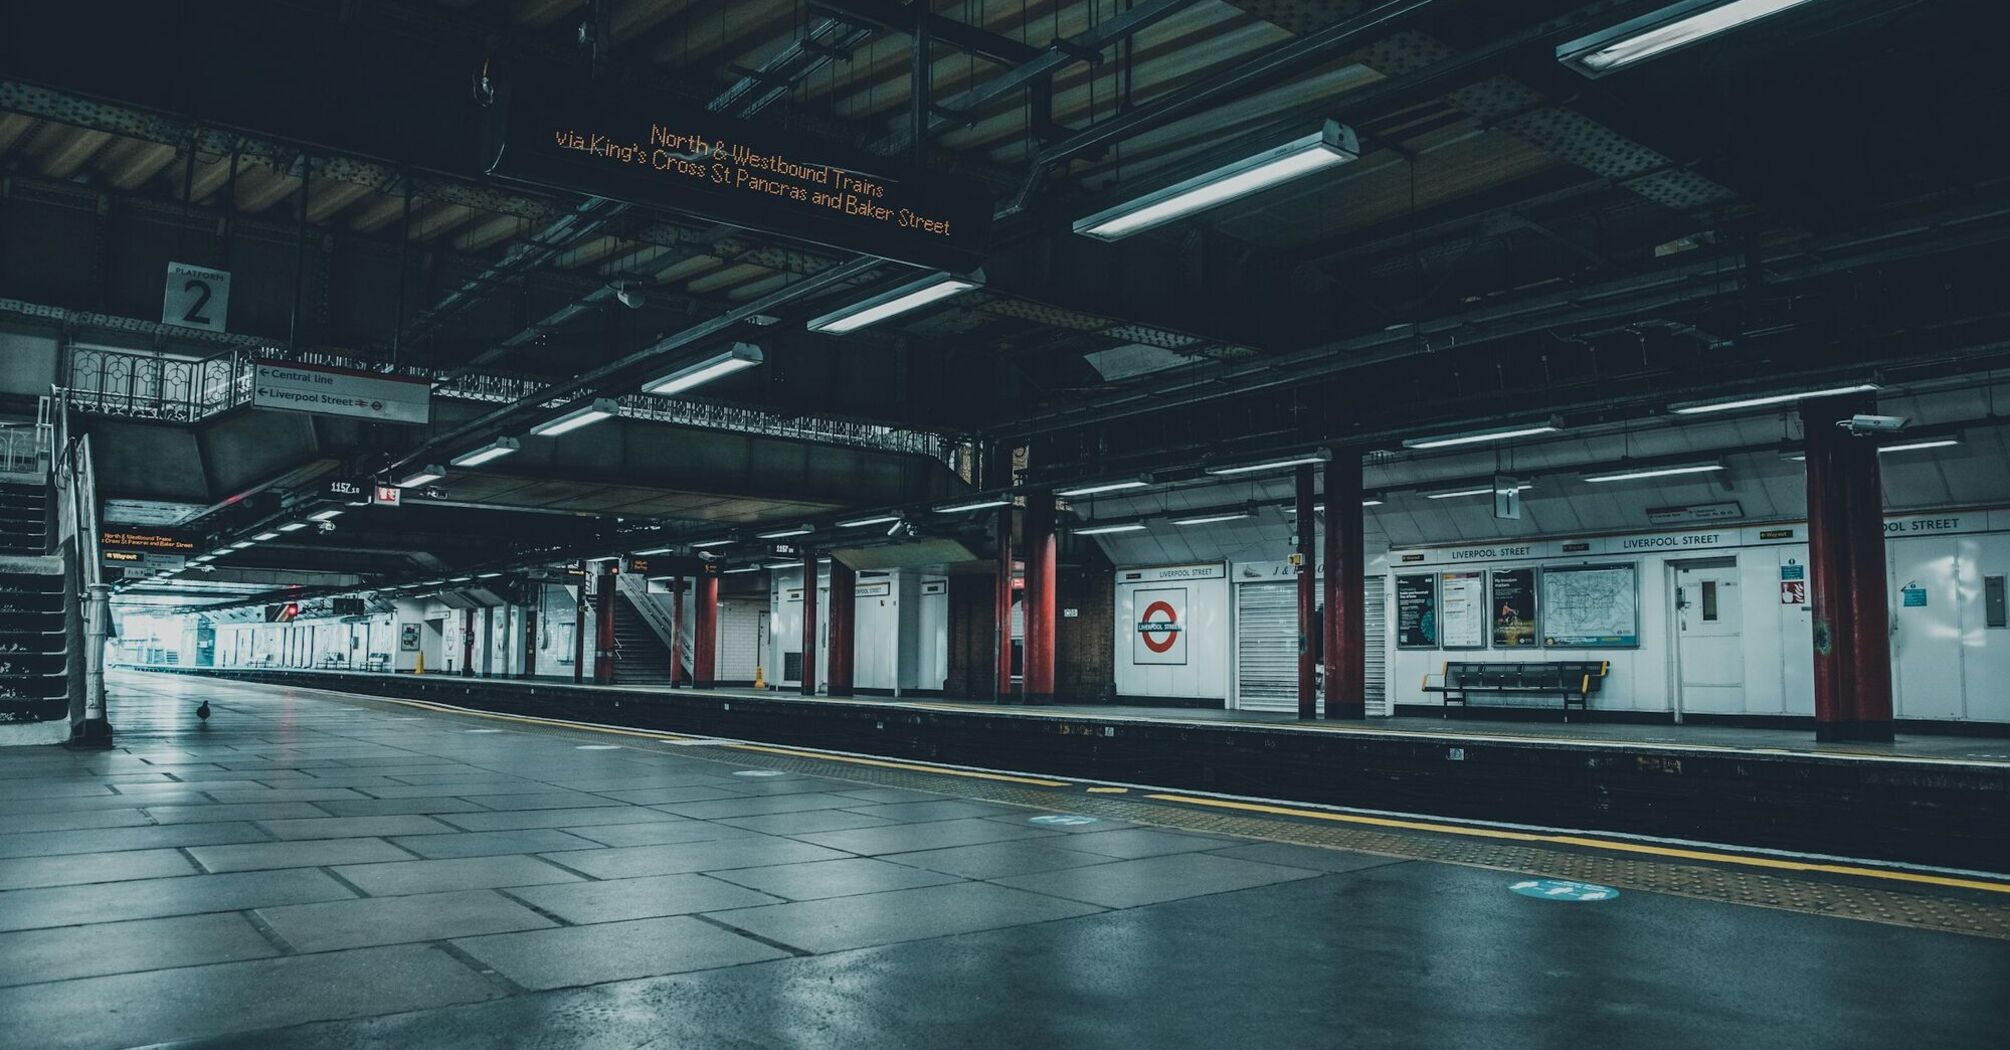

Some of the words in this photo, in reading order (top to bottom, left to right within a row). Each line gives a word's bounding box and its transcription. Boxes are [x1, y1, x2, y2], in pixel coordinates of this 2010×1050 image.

[651, 124, 708, 155] North
[713, 141, 726, 159] &
[732, 144, 827, 184] Westbound
[832, 169, 883, 197] Trains
[556, 130, 585, 149] via
[591, 135, 646, 163] King's
[652, 150, 706, 177] Cross
[711, 163, 730, 183] St
[736, 169, 807, 200] Pancras
[811, 193, 842, 210] and
[845, 195, 893, 220] Baker
[899, 208, 949, 236] Street
[175, 267, 224, 281] PLATFORM
[183, 280, 212, 325] 2
[271, 369, 311, 381] Central
[314, 374, 333, 385] line
[270, 389, 318, 402] Liverpool
[321, 394, 354, 406] Street
[1912, 518, 1959, 530] STREET
[1623, 536, 1679, 549] LIVERPOOL
[1682, 534, 1719, 545] STREET
[1452, 549, 1497, 559] LIVERPOOL
[1500, 547, 1530, 556] STREET
[1160, 569, 1190, 578] LIVERPOOL
[1192, 568, 1212, 576] STREET
[1273, 565, 1278, 576] J
[1282, 567, 1289, 576] &
[1139, 623, 1163, 631] LIVERPOOL
